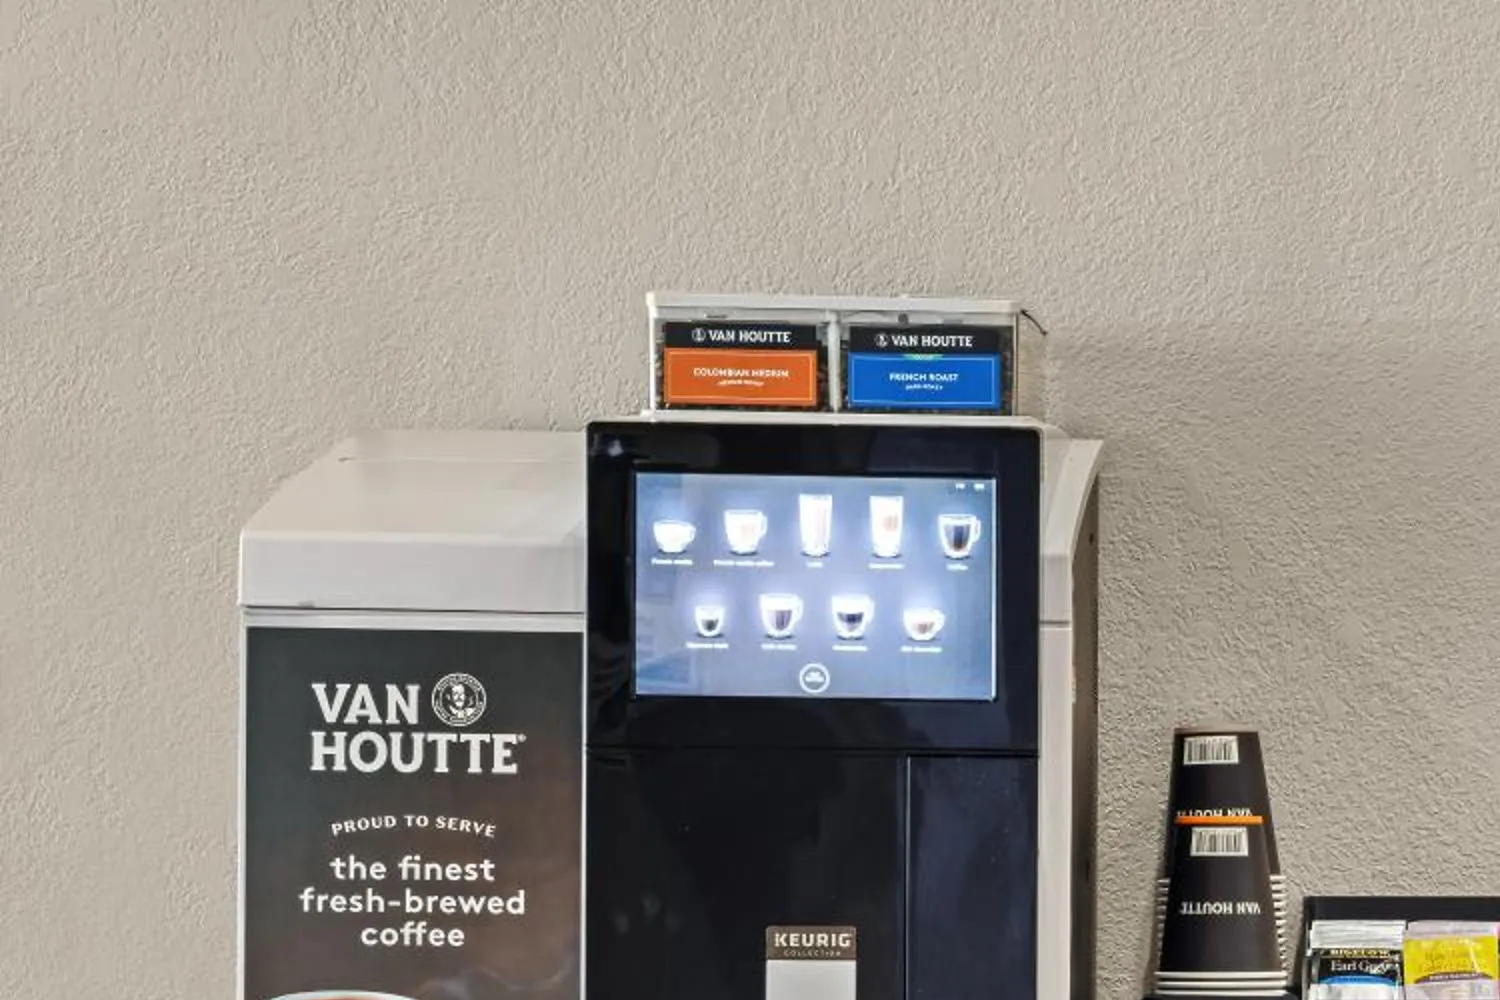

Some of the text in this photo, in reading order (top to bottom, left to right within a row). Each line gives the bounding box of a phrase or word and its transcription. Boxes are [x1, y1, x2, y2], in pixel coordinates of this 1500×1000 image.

[708, 329, 792, 343] VAN HOUTTE
[891, 335, 973, 347] VAN HOUTTE
[889, 372, 959, 382] FRENCH ROAST
[311, 683, 421, 725] VAN
[331, 815, 496, 838] PROUD TO SERVE
[329, 854, 496, 882] the finest
[299, 887, 526, 915] fresh-brewed
[1180, 901, 1261, 915] VAN HOUTTE
[360, 921, 465, 946] coffee
[774, 933, 852, 947] KEURIG
[1330, 959, 1357, 971] Earl
